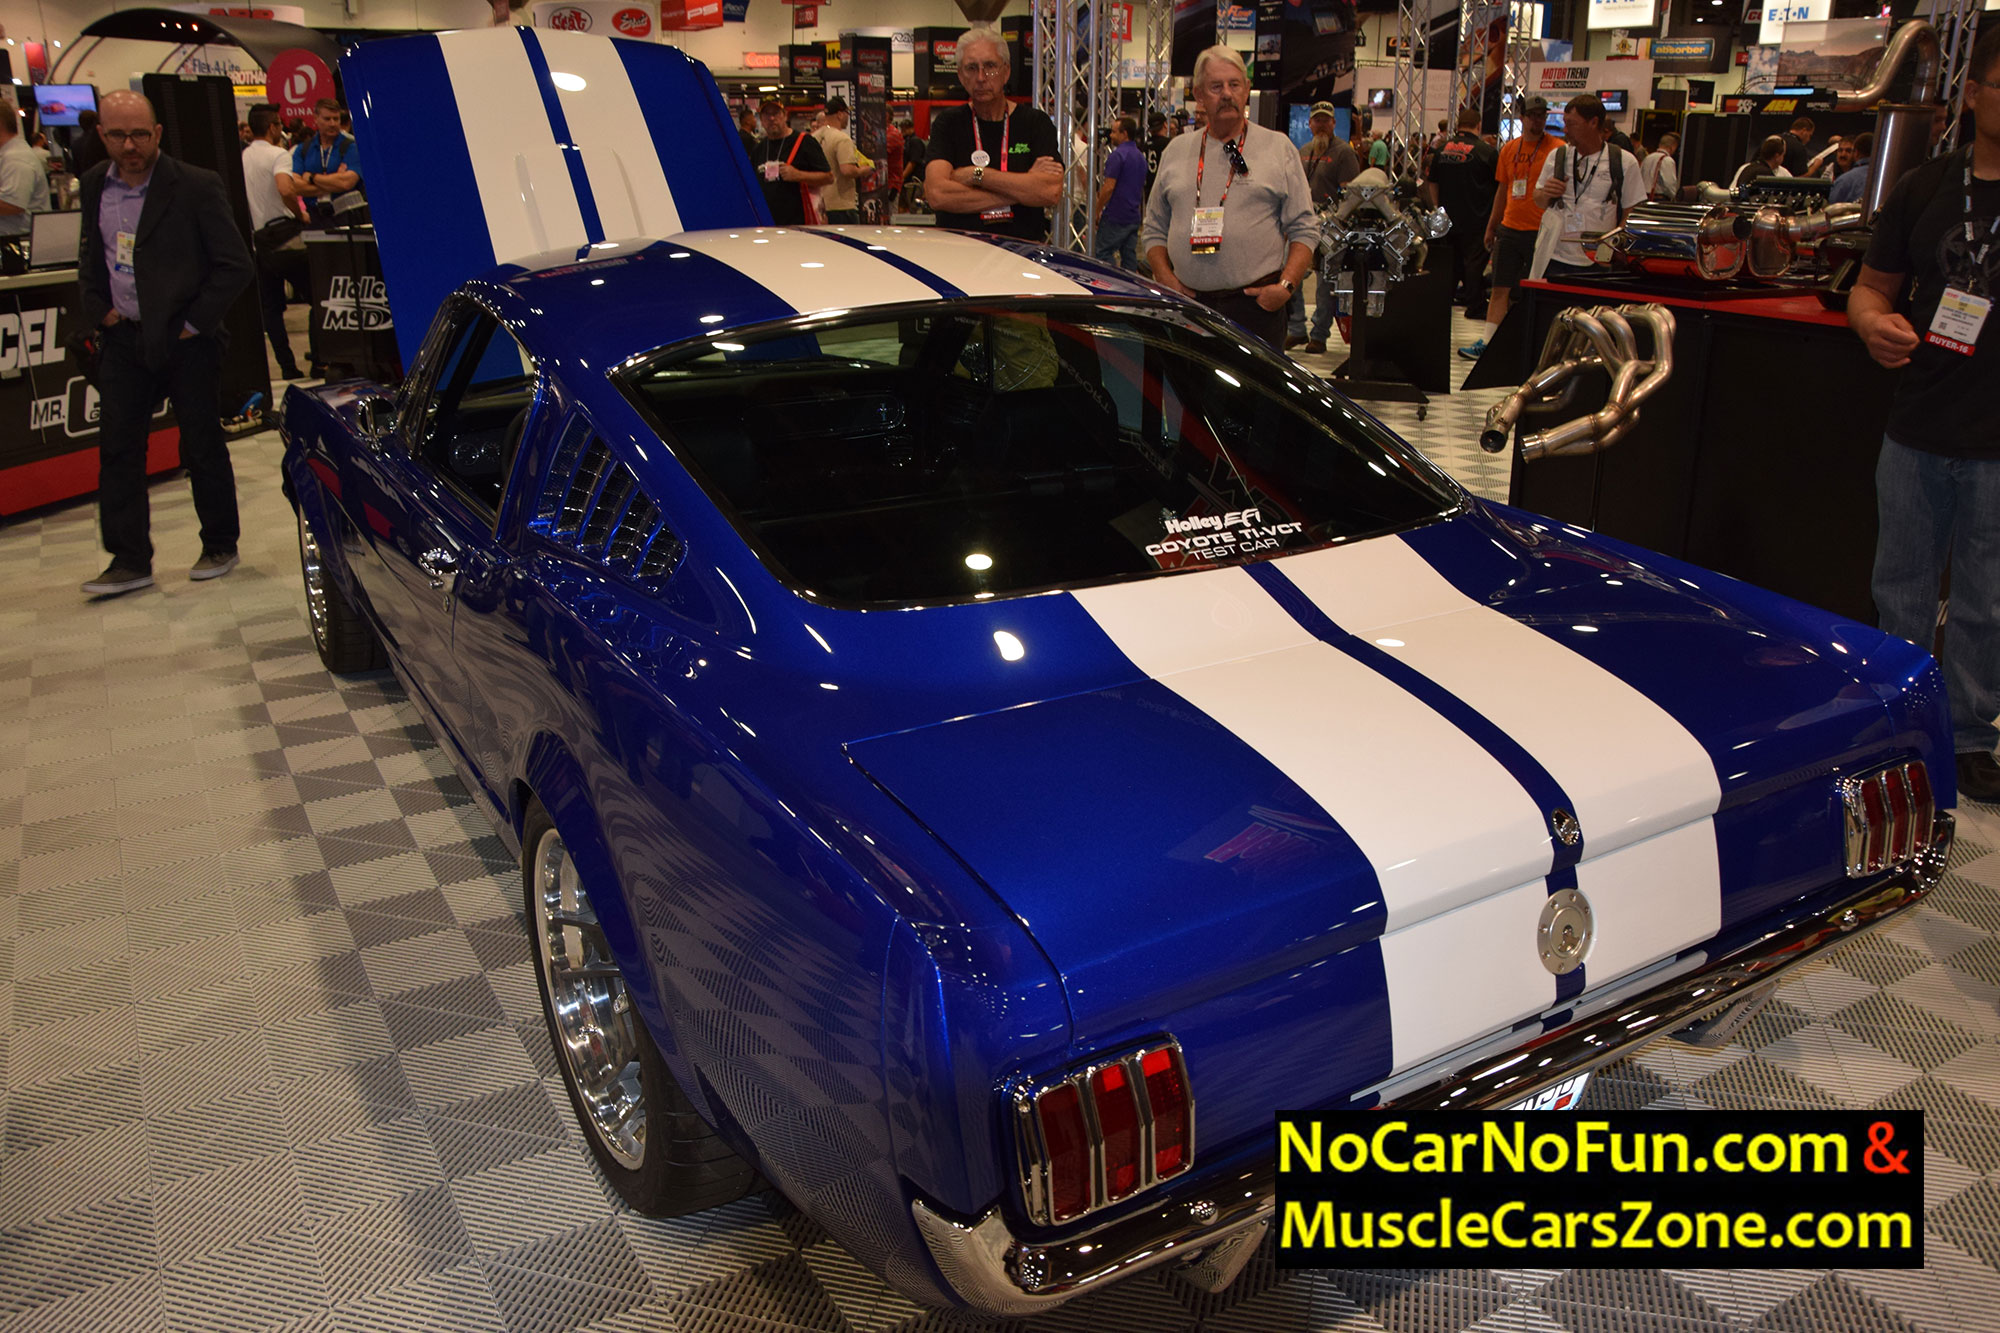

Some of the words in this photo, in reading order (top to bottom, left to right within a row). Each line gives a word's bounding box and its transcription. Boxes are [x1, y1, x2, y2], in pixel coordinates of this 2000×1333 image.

[286, 107, 314, 117] DINA
[329, 276, 388, 301] Holle
[1929, 335, 1970, 354] BUYER-16
[1164, 515, 1225, 534] Holley
[1145, 531, 1237, 556] COYOTE
[1238, 522, 1303, 540] TI-VCT
[1188, 544, 1236, 561] TEST
[1240, 537, 1280, 553] CAR
